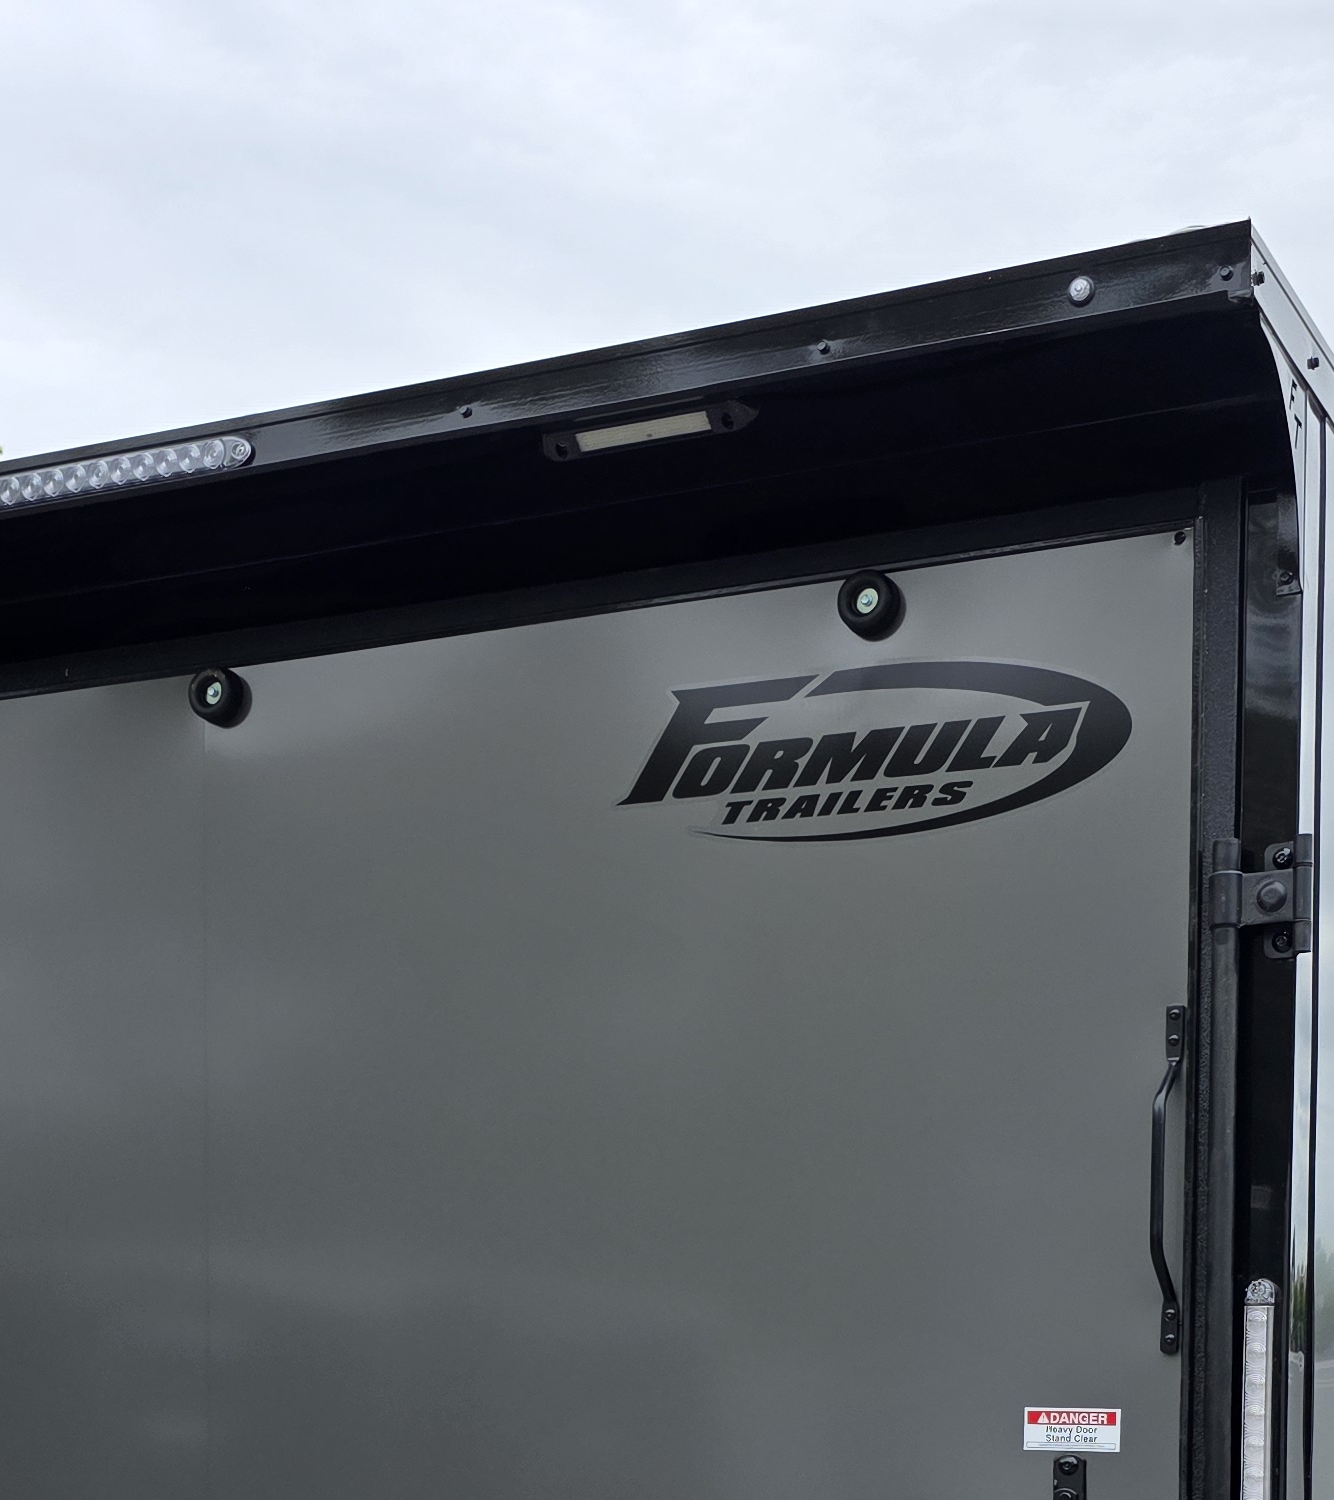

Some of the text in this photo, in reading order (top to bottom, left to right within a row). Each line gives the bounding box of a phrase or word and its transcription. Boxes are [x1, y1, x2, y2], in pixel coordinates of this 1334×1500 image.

[616, 674, 1087, 806] FORMULA
[721, 780, 974, 826] TRAILERS
[1049, 1412, 1108, 1425] DANGER
[1045, 1425, 1098, 1436] Heavy Door
[1045, 1434, 1098, 1443] Stand Clear
